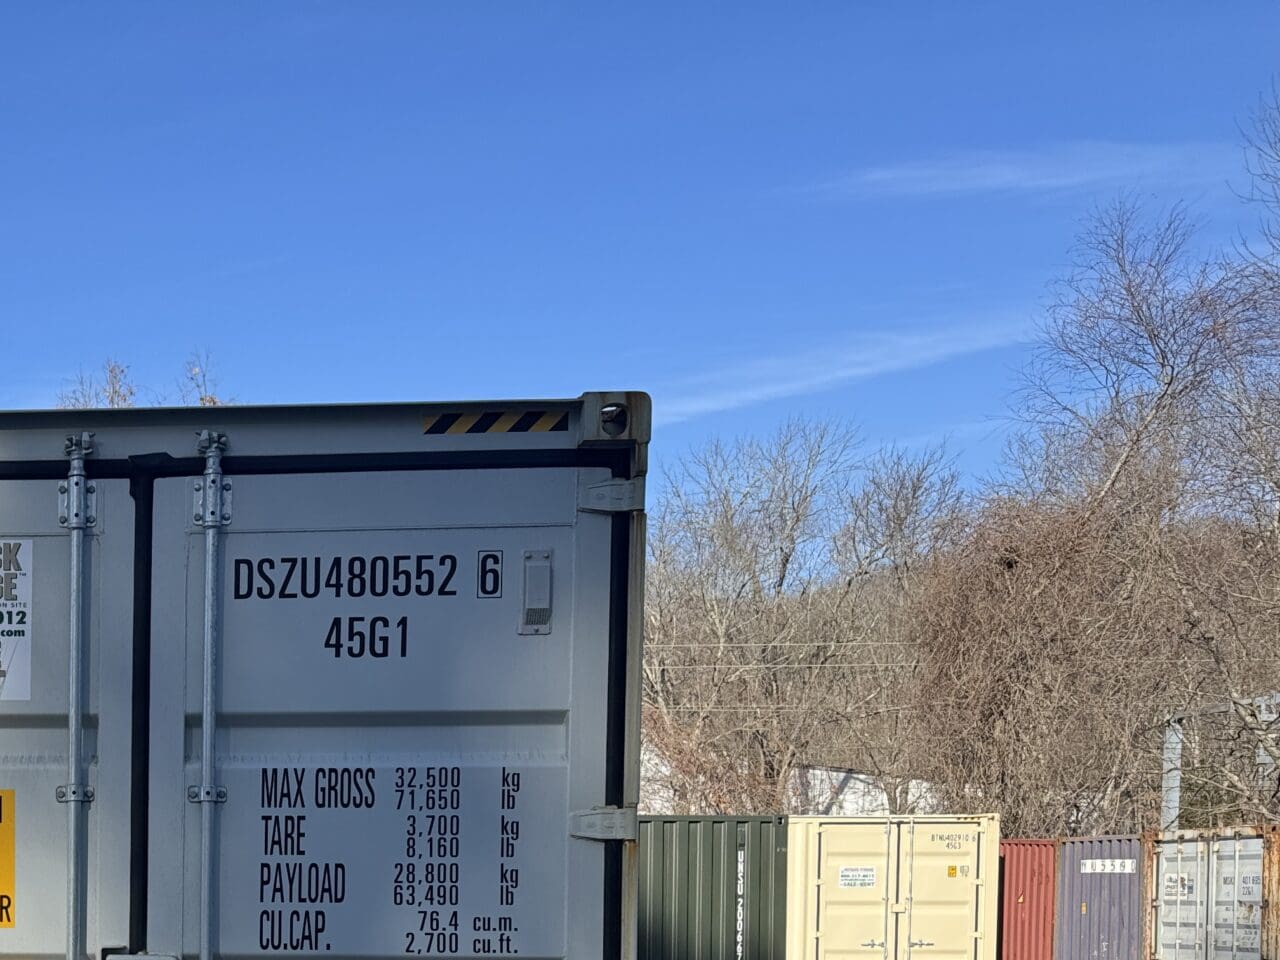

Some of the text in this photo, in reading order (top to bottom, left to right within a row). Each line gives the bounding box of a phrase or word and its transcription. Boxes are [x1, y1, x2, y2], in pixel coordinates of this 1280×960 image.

[480, 553, 500, 596] 6
[324, 616, 408, 658] 45G1
[261, 767, 376, 809] MAX GROSS
[395, 766, 521, 793] 32,500 kg
[395, 789, 516, 812] 71,650 lb
[261, 815, 306, 856] TARE
[406, 814, 520, 841] 3,700 kg
[406, 836, 515, 860] 8,160 lb
[259, 862, 346, 904] PAYLOAD
[393, 862, 519, 889] 28,800 kg
[393, 884, 515, 908] 63,490 lb
[259, 909, 331, 951] CU.CAP.
[417, 910, 519, 932] 76.4 cu.m.
[405, 932, 519, 955] 2,700 cu.ft.
